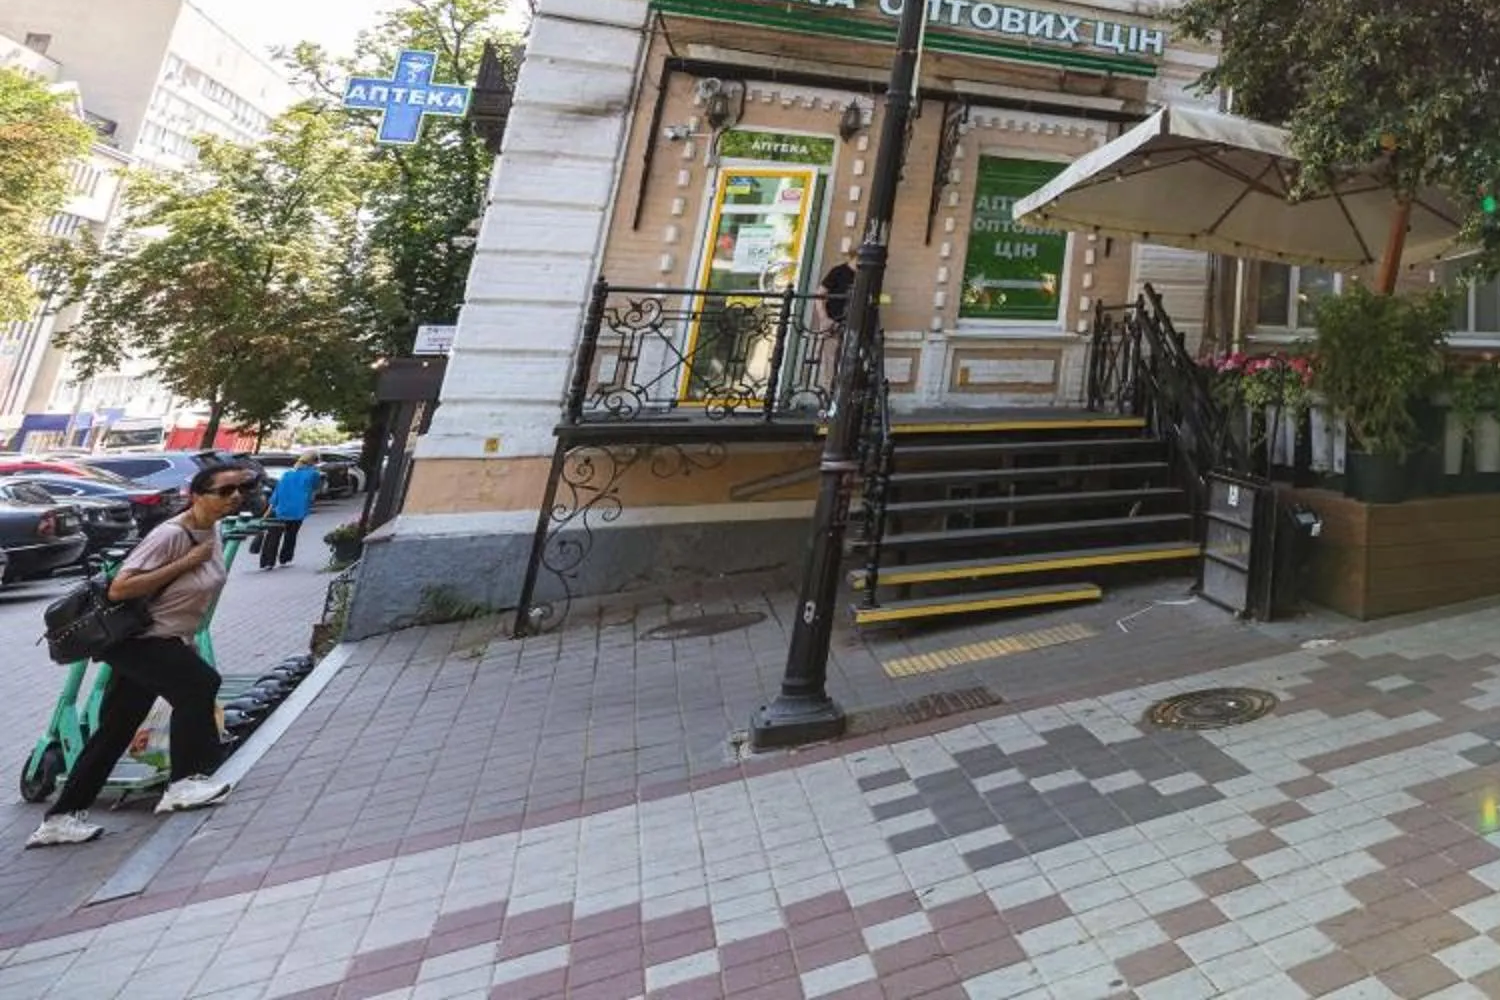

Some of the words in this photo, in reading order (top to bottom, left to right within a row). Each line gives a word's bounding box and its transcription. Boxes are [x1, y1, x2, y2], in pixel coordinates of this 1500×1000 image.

[1095, 20, 1164, 55] ЦІН
[345, 84, 464, 108] АПТЕКА
[751, 139, 809, 155] АПТЕКА
[994, 240, 1038, 260] ЦІН
